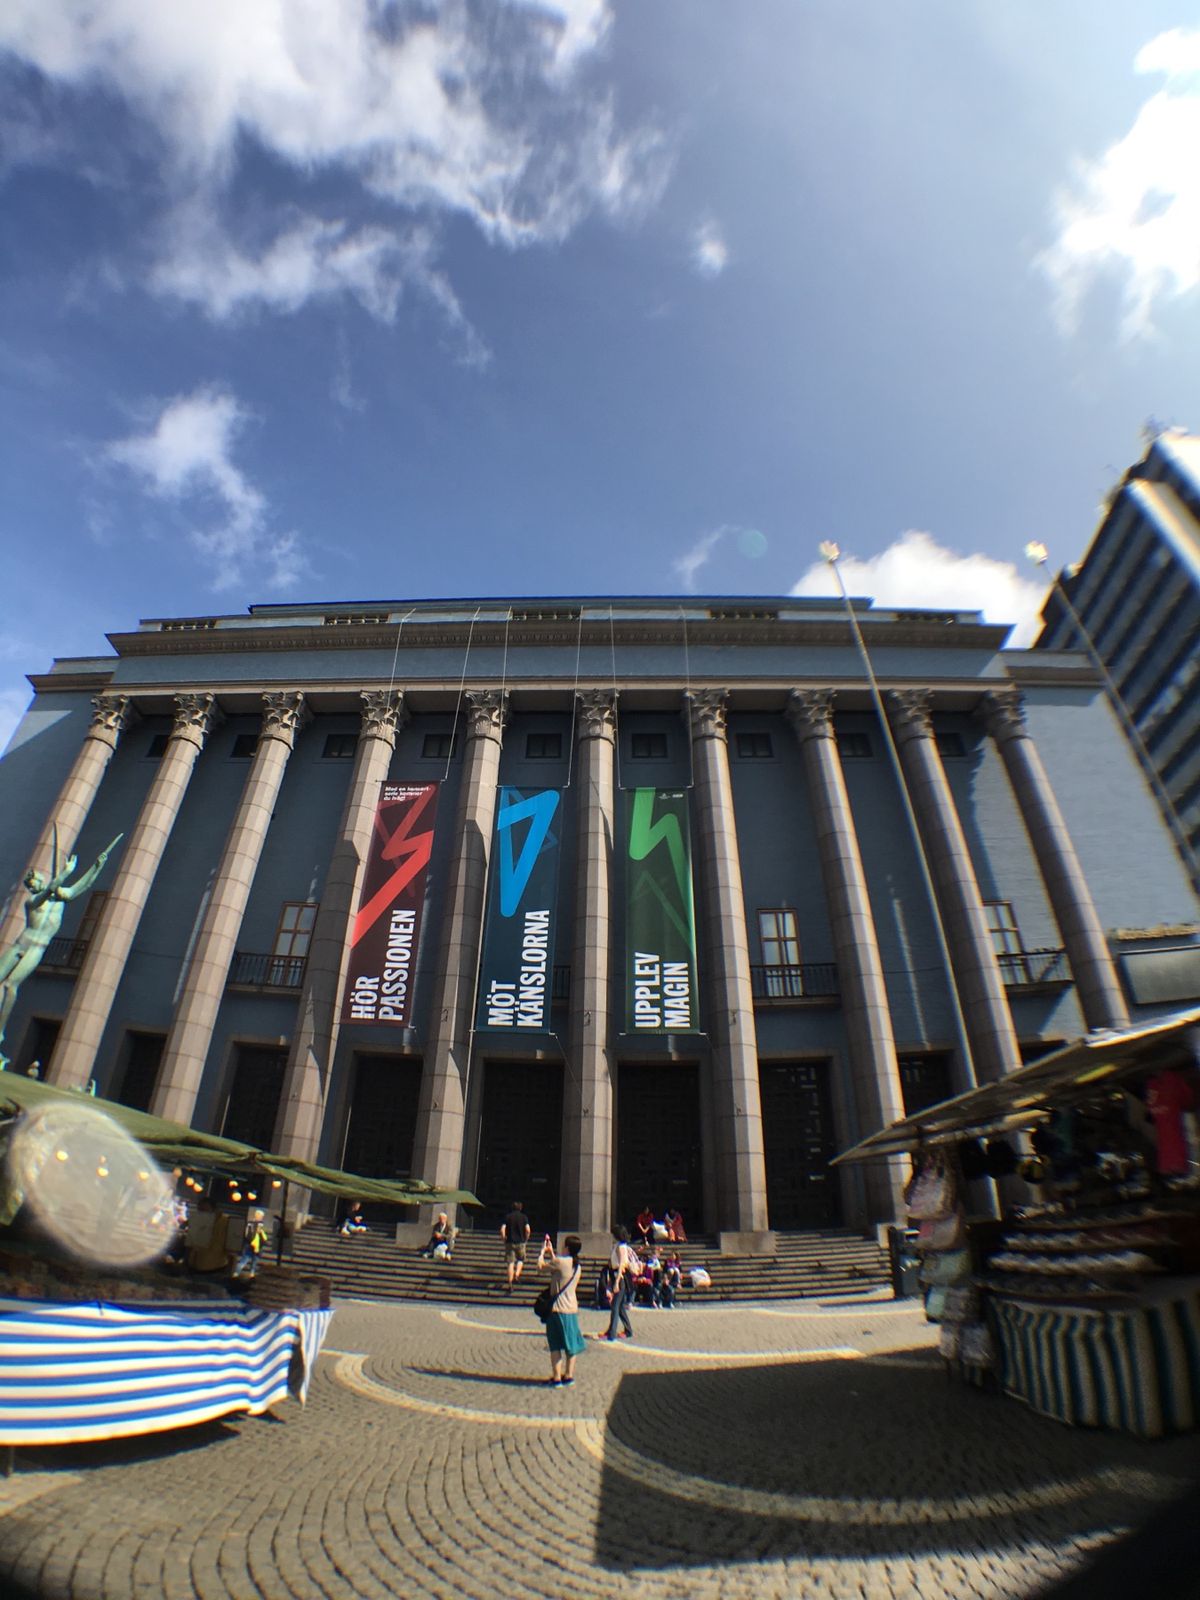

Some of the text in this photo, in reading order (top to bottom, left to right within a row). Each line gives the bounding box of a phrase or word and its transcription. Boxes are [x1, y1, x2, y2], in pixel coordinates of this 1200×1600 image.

[350, 976, 380, 1019] HÖR
[378, 910, 416, 1021] PASSIONEN
[514, 910, 550, 1027] KÄNSLORNA
[635, 952, 661, 1027] UPPLEV
[663, 962, 690, 1027] MAGIN
[486, 980, 516, 1026] MÖT
